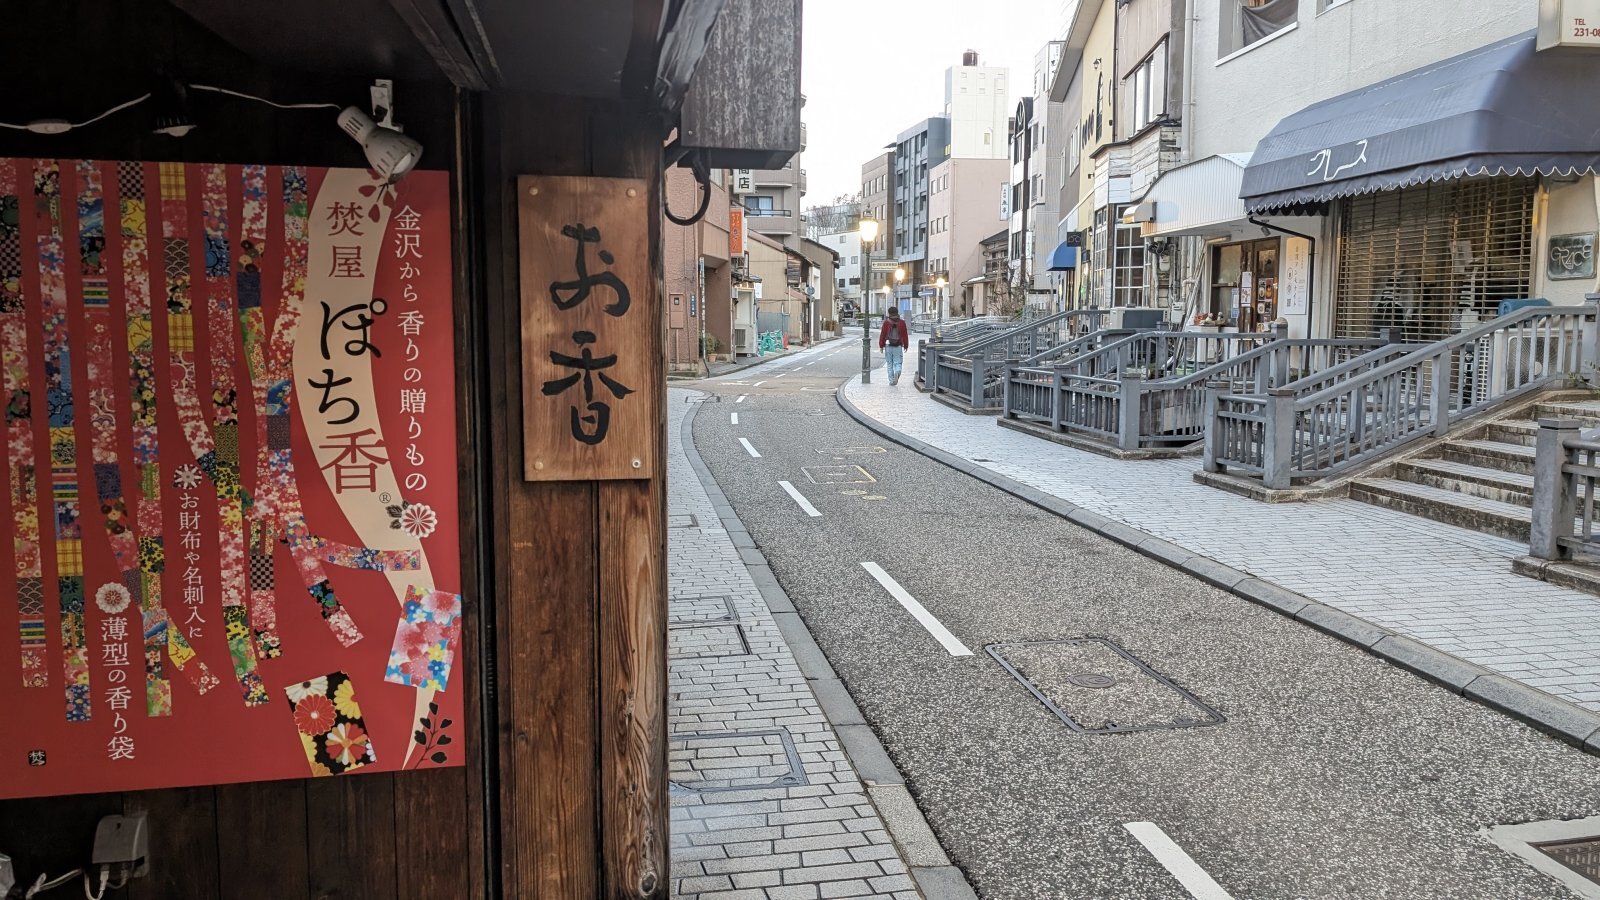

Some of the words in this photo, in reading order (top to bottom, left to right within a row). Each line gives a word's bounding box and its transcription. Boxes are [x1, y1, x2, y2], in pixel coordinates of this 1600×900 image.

[1574, 18, 1586, 26] TEL
[307, 298, 390, 494] ぽち香
[393, 204, 427, 491] 金沢から香りの贈りもの
[541, 223, 637, 445] お香
[178, 492, 206, 638] お財布や名刺入に
[100, 617, 135, 760] 薄型の香り袋
